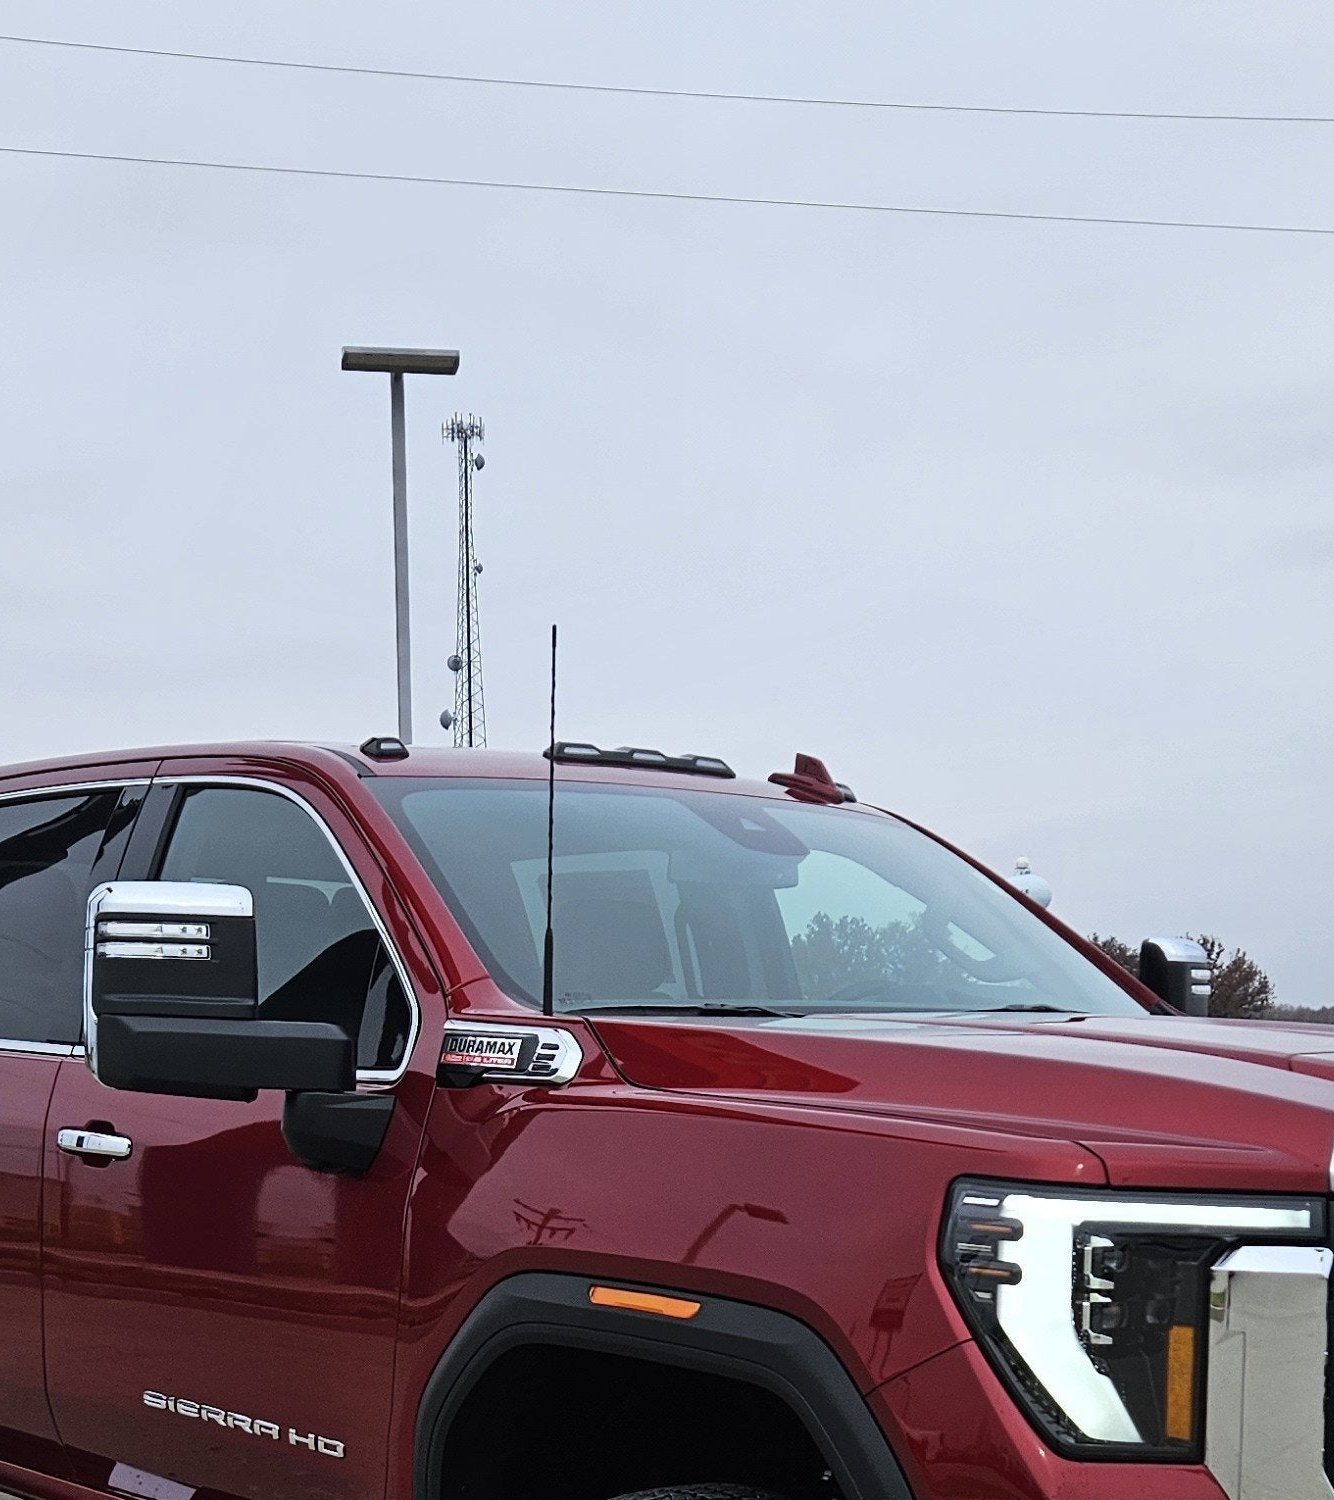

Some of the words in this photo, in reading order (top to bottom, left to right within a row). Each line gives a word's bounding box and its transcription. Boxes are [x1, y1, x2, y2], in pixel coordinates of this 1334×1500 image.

[447, 1037, 516, 1056] DURAMAX
[143, 1390, 279, 1440] SIERRA
[288, 1428, 345, 1458] HD
